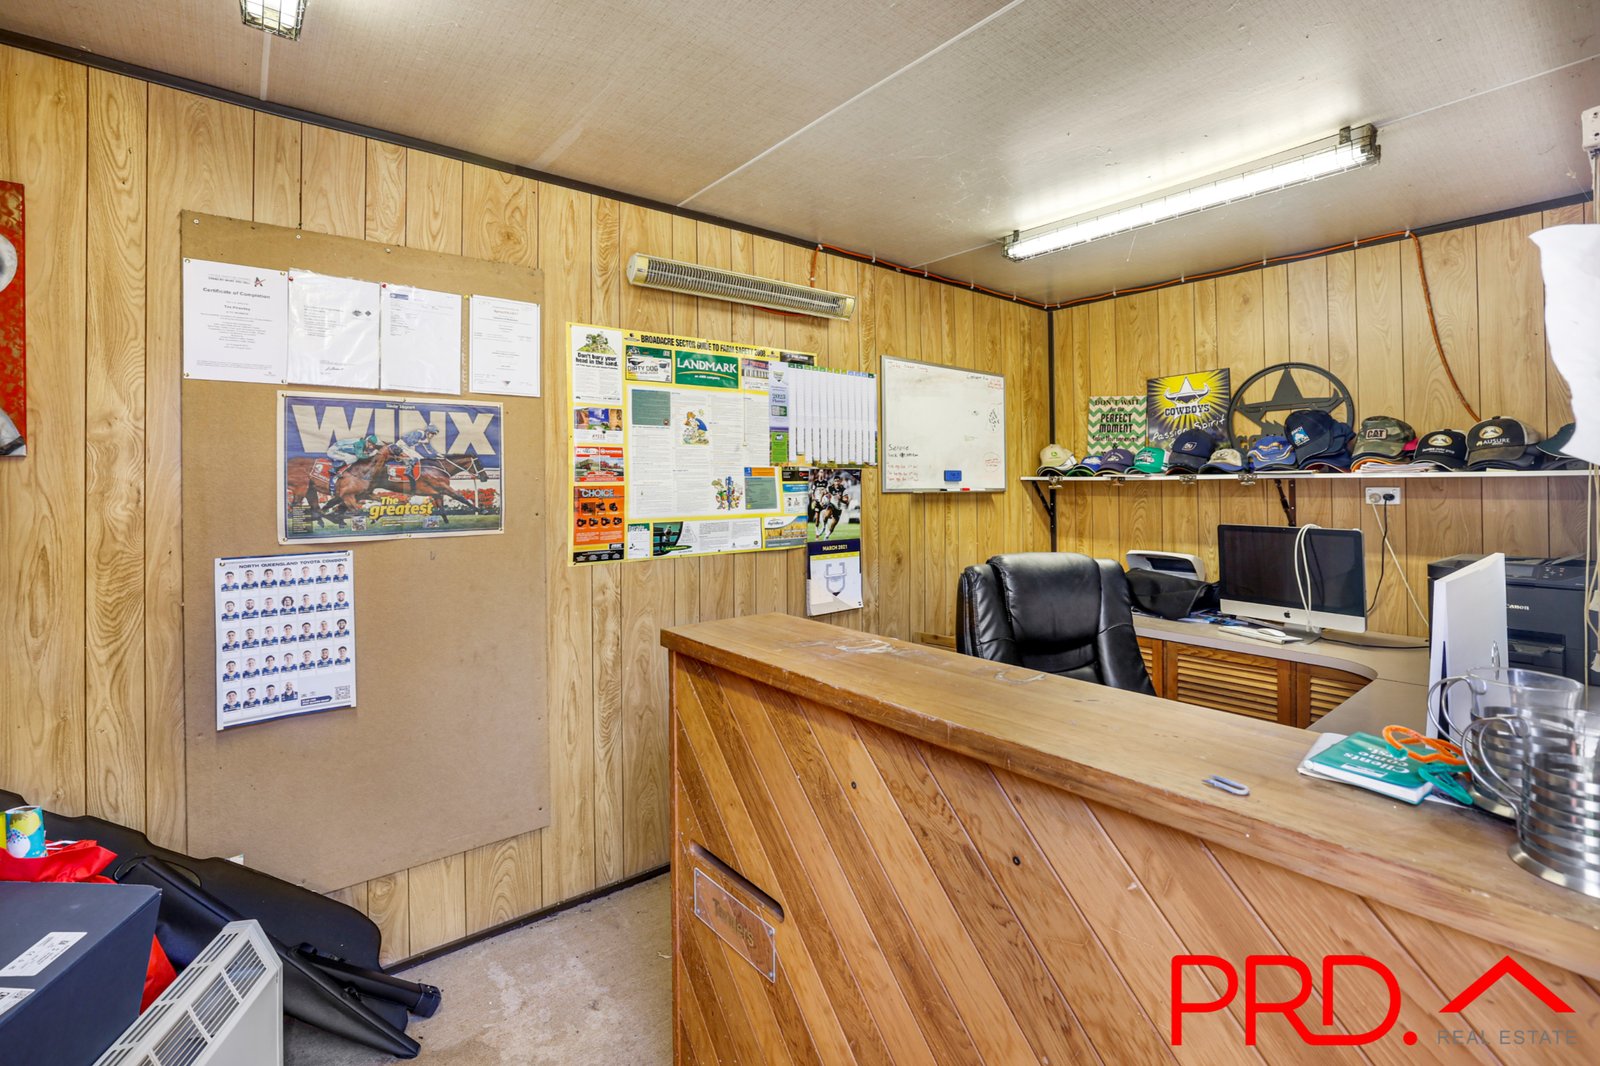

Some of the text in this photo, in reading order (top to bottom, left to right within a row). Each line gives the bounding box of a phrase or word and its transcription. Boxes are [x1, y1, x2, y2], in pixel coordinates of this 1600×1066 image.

[202, 287, 232, 295] Certificate
[239, 291, 271, 300] Completion
[640, 334, 675, 347] BROADACRE
[675, 338, 696, 349] SECTOR
[696, 341, 711, 351] GUIDE
[712, 343, 720, 352] TO
[720, 344, 736, 355] FARM
[676, 357, 737, 373] LANDMARK
[1164, 404, 1210, 416] COWBOYS
[1100, 413, 1132, 423] PERFECT
[1193, 413, 1225, 430] Spirit
[292, 404, 497, 456] WINX
[1098, 423, 1133, 433] MOMENT
[1367, 429, 1384, 439] CAT
[581, 488, 614, 498] CHOICE
[380, 496, 399, 505] The
[369, 501, 433, 520] greatest
[1343, 752, 1410, 774] Clients
[1358, 751, 1409, 767] come
